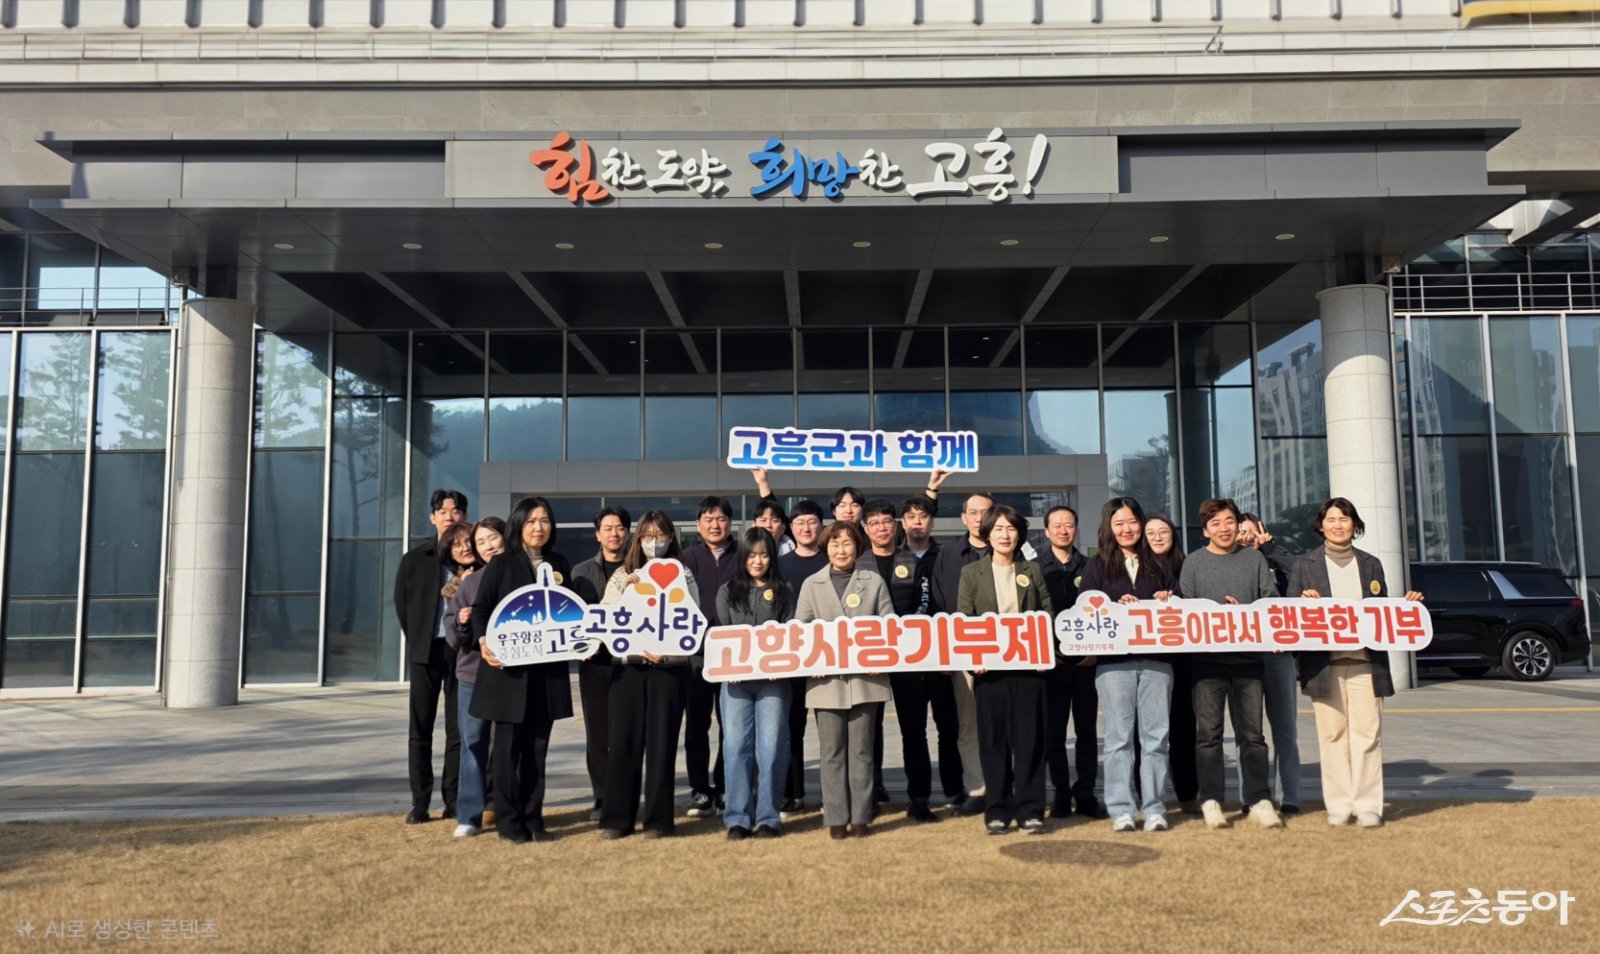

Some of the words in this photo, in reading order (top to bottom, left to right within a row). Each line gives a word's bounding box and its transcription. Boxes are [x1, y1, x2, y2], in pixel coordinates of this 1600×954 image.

[529, 130, 646, 203] 힘찬
[646, 148, 728, 197] 도약,
[748, 136, 904, 200] 희망찬
[905, 127, 1048, 202] 고흥!
[731, 430, 888, 468] 고흥군과
[898, 433, 976, 469] 함께
[497, 629, 543, 647] 우주항공
[585, 592, 704, 653] 고흥사랑
[1061, 610, 1120, 641] 고흥사랑
[1127, 605, 1262, 646] 고흥이라서
[1267, 603, 1360, 646] 행복한
[1363, 605, 1426, 645] 기부
[499, 643, 544, 661] 중심도시
[707, 615, 1051, 676] 고향사랑기부제
